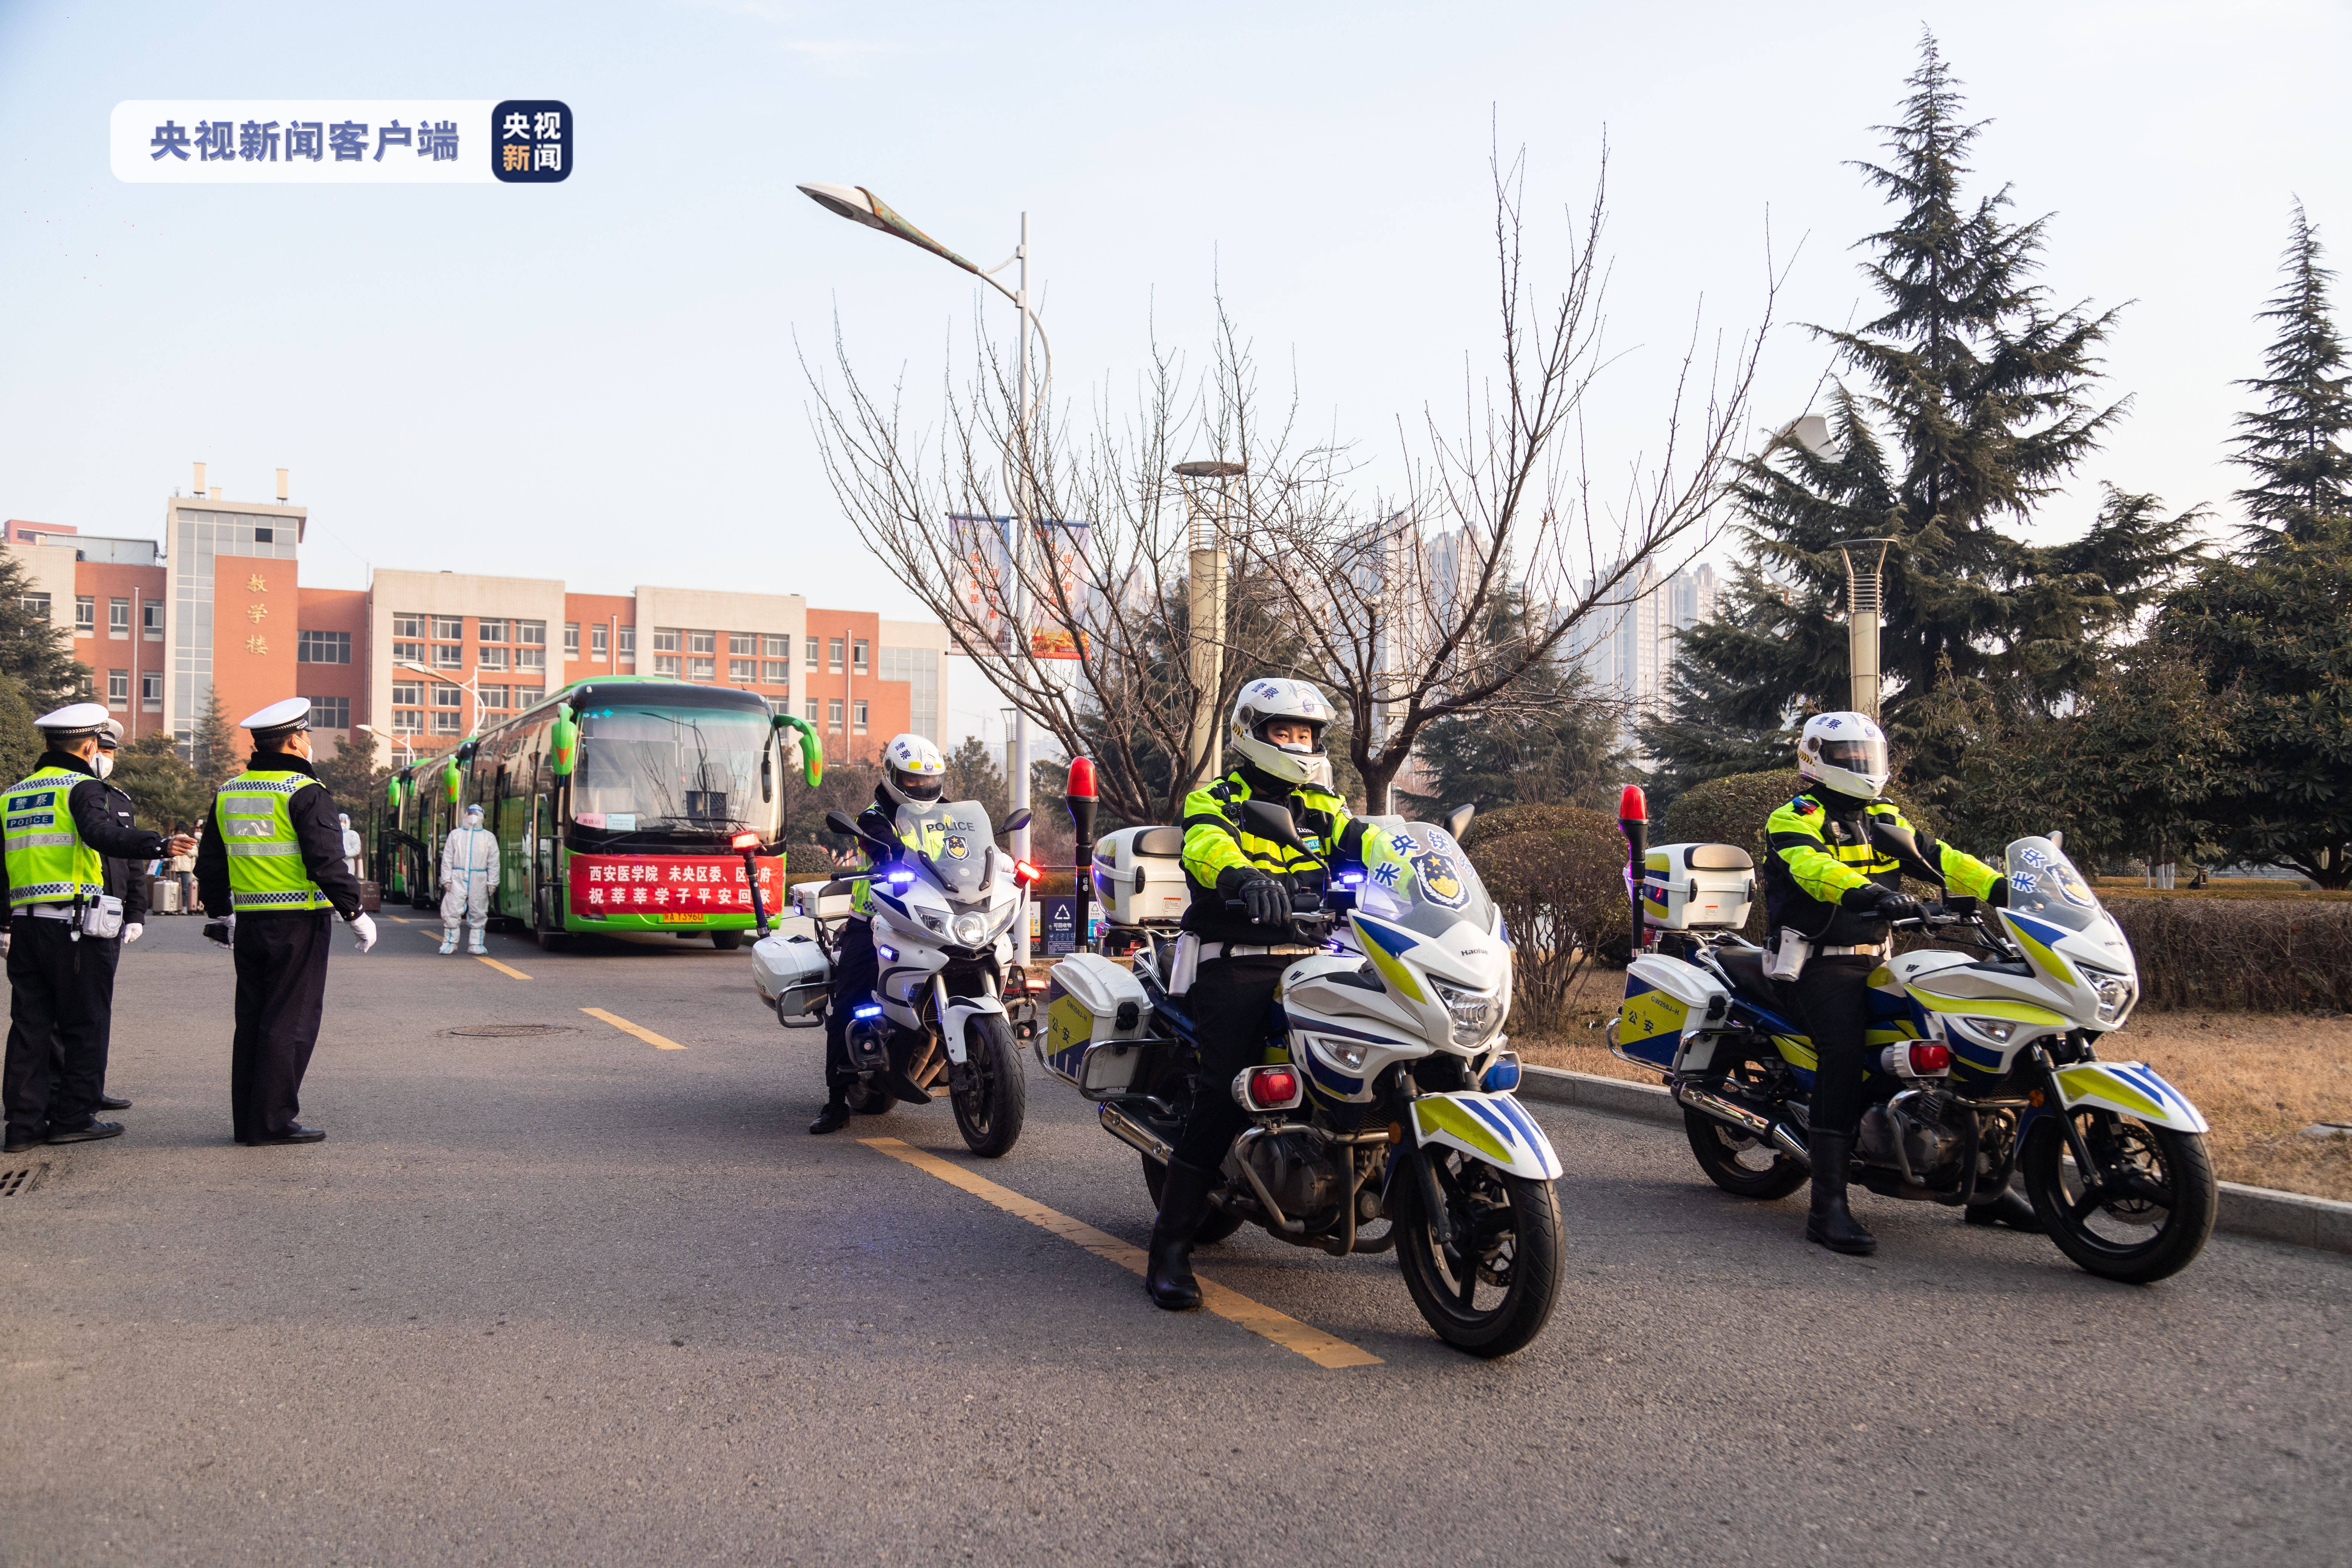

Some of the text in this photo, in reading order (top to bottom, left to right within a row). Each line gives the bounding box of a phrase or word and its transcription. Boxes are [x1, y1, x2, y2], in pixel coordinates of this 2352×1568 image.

[245, 573, 269, 655] 教学楼
[1251, 682, 1279, 700] 警察
[1815, 716, 1842, 730] 警察
[895, 741, 911, 760] 警察
[15, 794, 48, 810] 警察
[11, 816, 49, 827] POLICE
[926, 821, 975, 833] POLICE
[589, 865, 771, 882] 西安医学院 未央区委、区府
[1651, 996, 1680, 1015] GW250J-H
[1052, 1017, 1069, 1044] 公安
[1628, 1011, 1654, 1034] 公安
